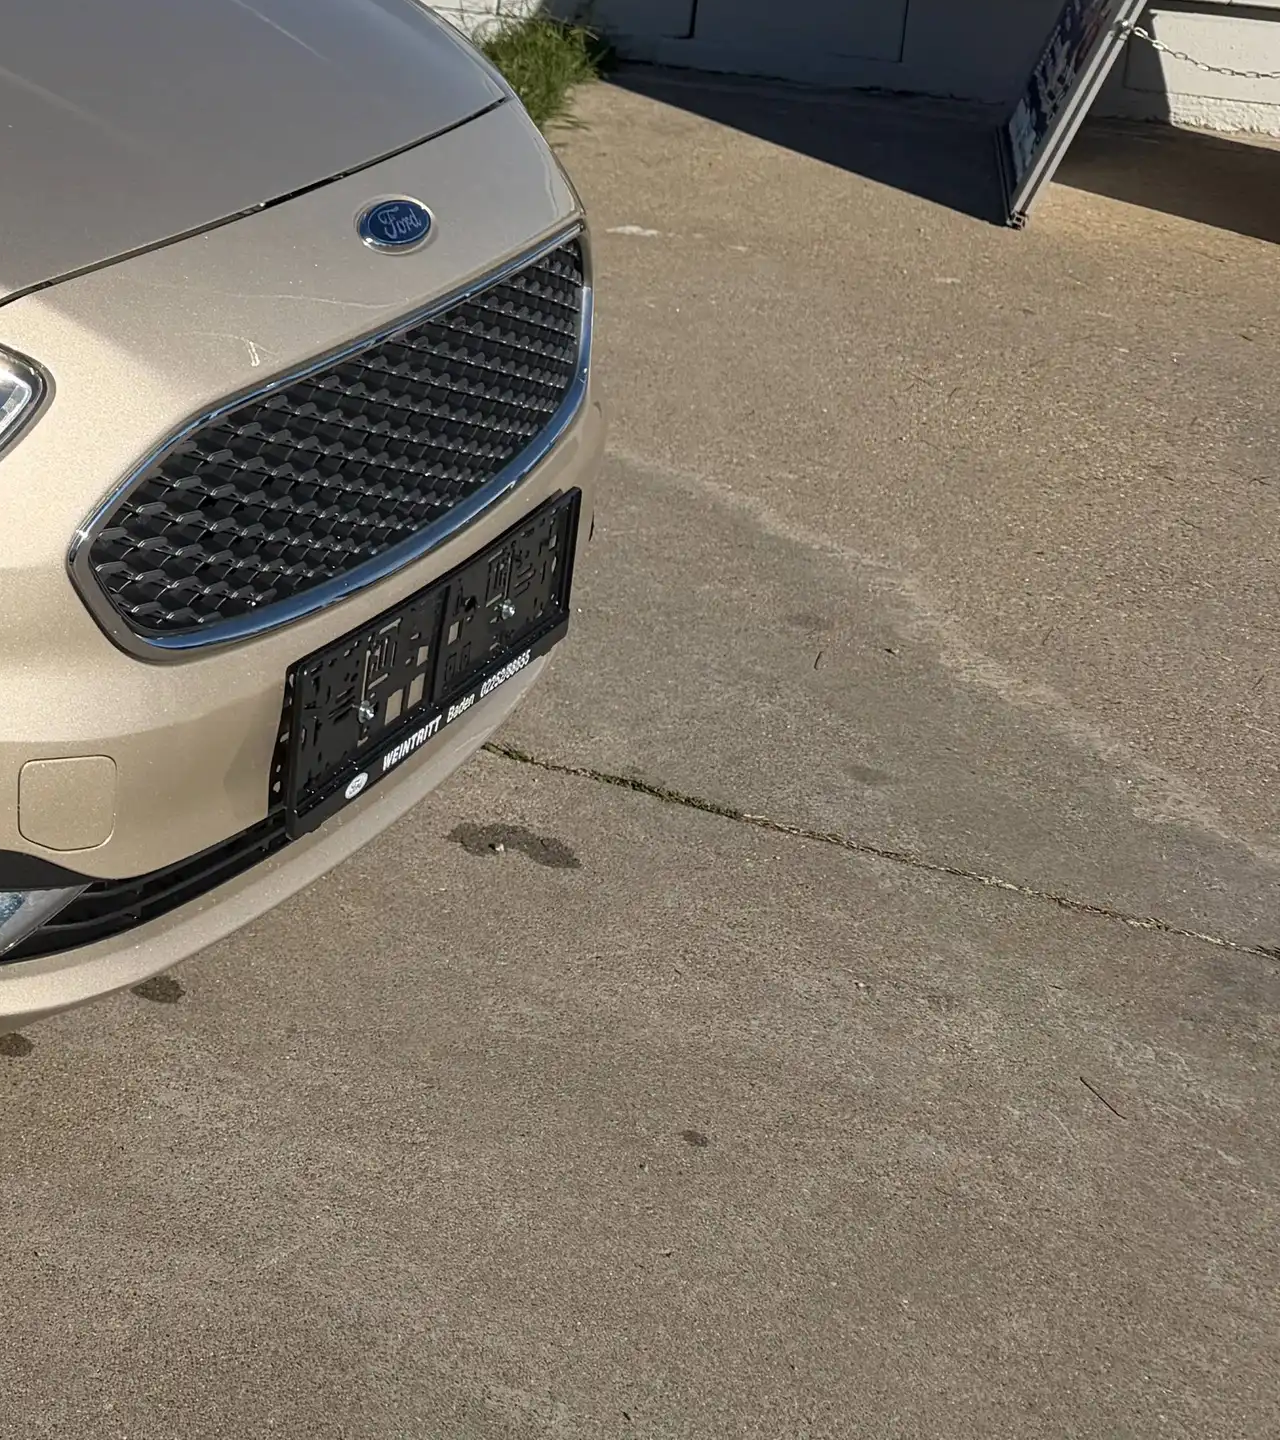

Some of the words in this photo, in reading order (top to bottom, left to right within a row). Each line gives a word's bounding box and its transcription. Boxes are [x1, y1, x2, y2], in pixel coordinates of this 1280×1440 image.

[377, 205, 422, 240] Ford
[382, 714, 442, 771] WEINTRITT
[446, 693, 475, 723] Baden
